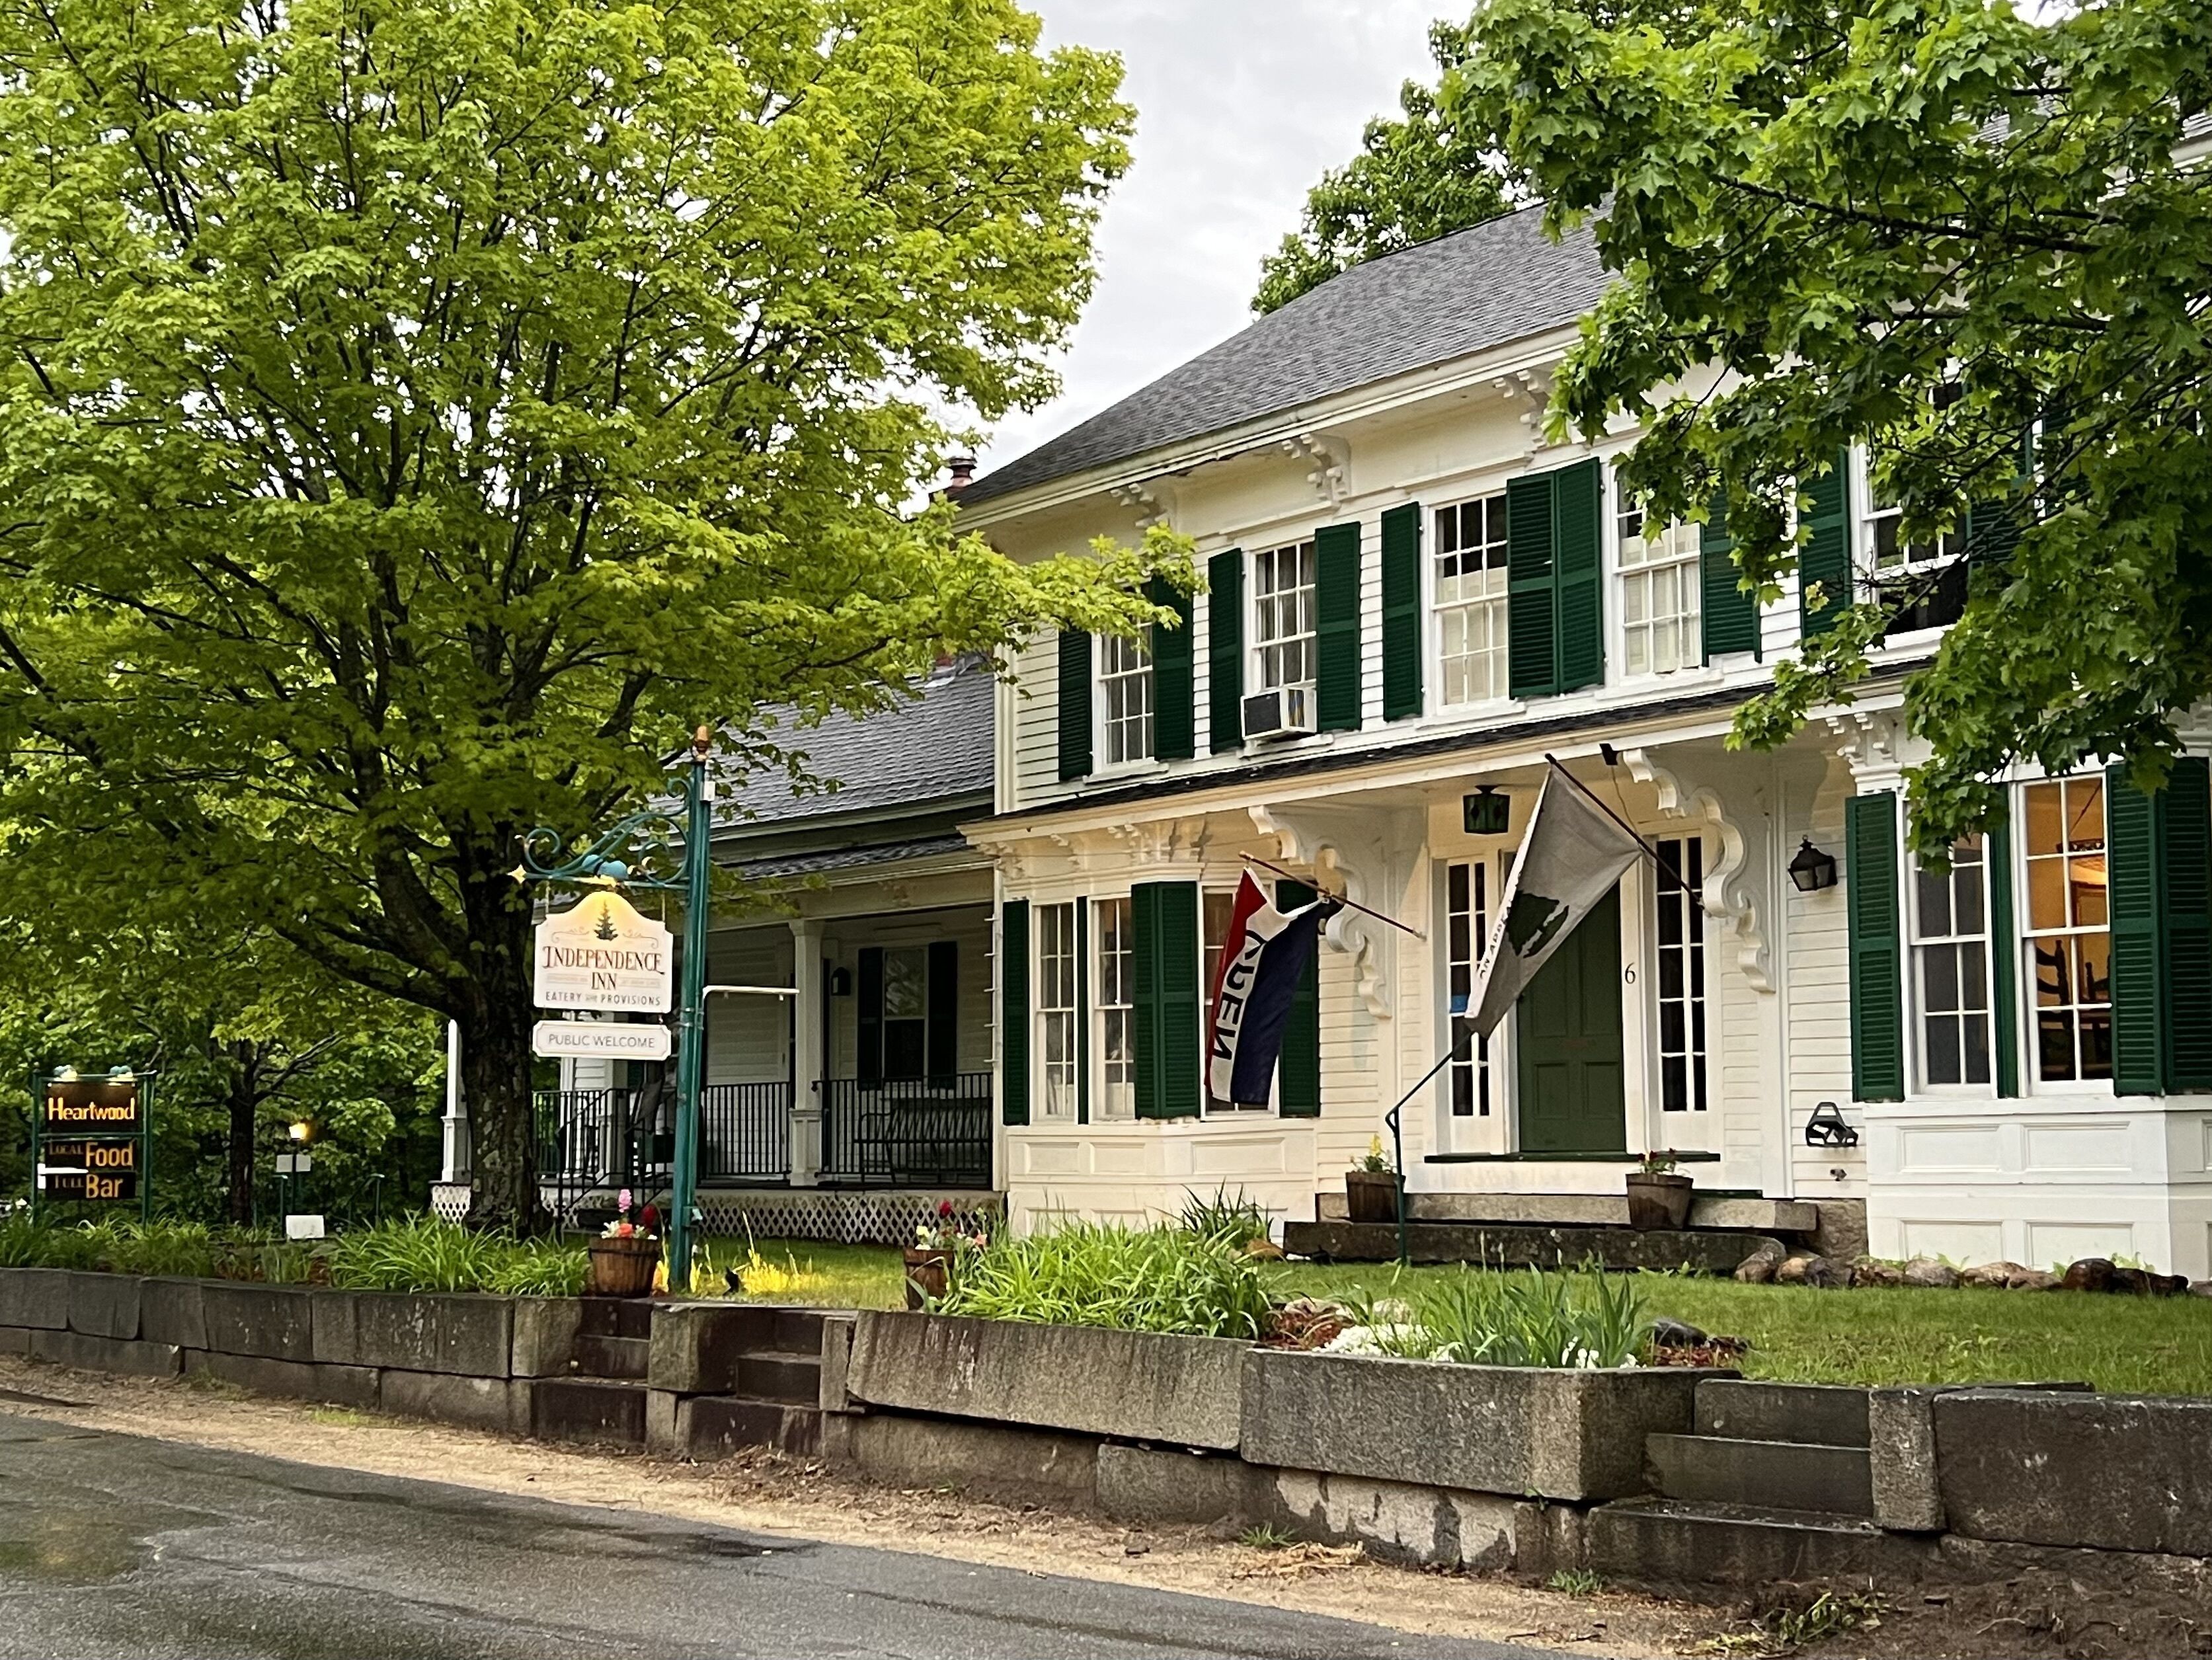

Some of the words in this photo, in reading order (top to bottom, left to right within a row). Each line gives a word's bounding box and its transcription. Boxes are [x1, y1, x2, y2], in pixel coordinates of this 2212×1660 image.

[542, 946, 665, 975] INDEPENDENCE
[591, 972, 617, 990] INN
[1624, 962, 1636, 985] 6
[545, 992, 582, 1002] EATERY
[600, 994, 661, 1006] PROVISIONS
[549, 1033, 590, 1047] PUBLIC
[593, 1035, 655, 1048] WELCOME
[48, 1097, 136, 1121] Heartwood
[85, 1142, 133, 1167] Food
[86, 1173, 124, 1199] Bar
